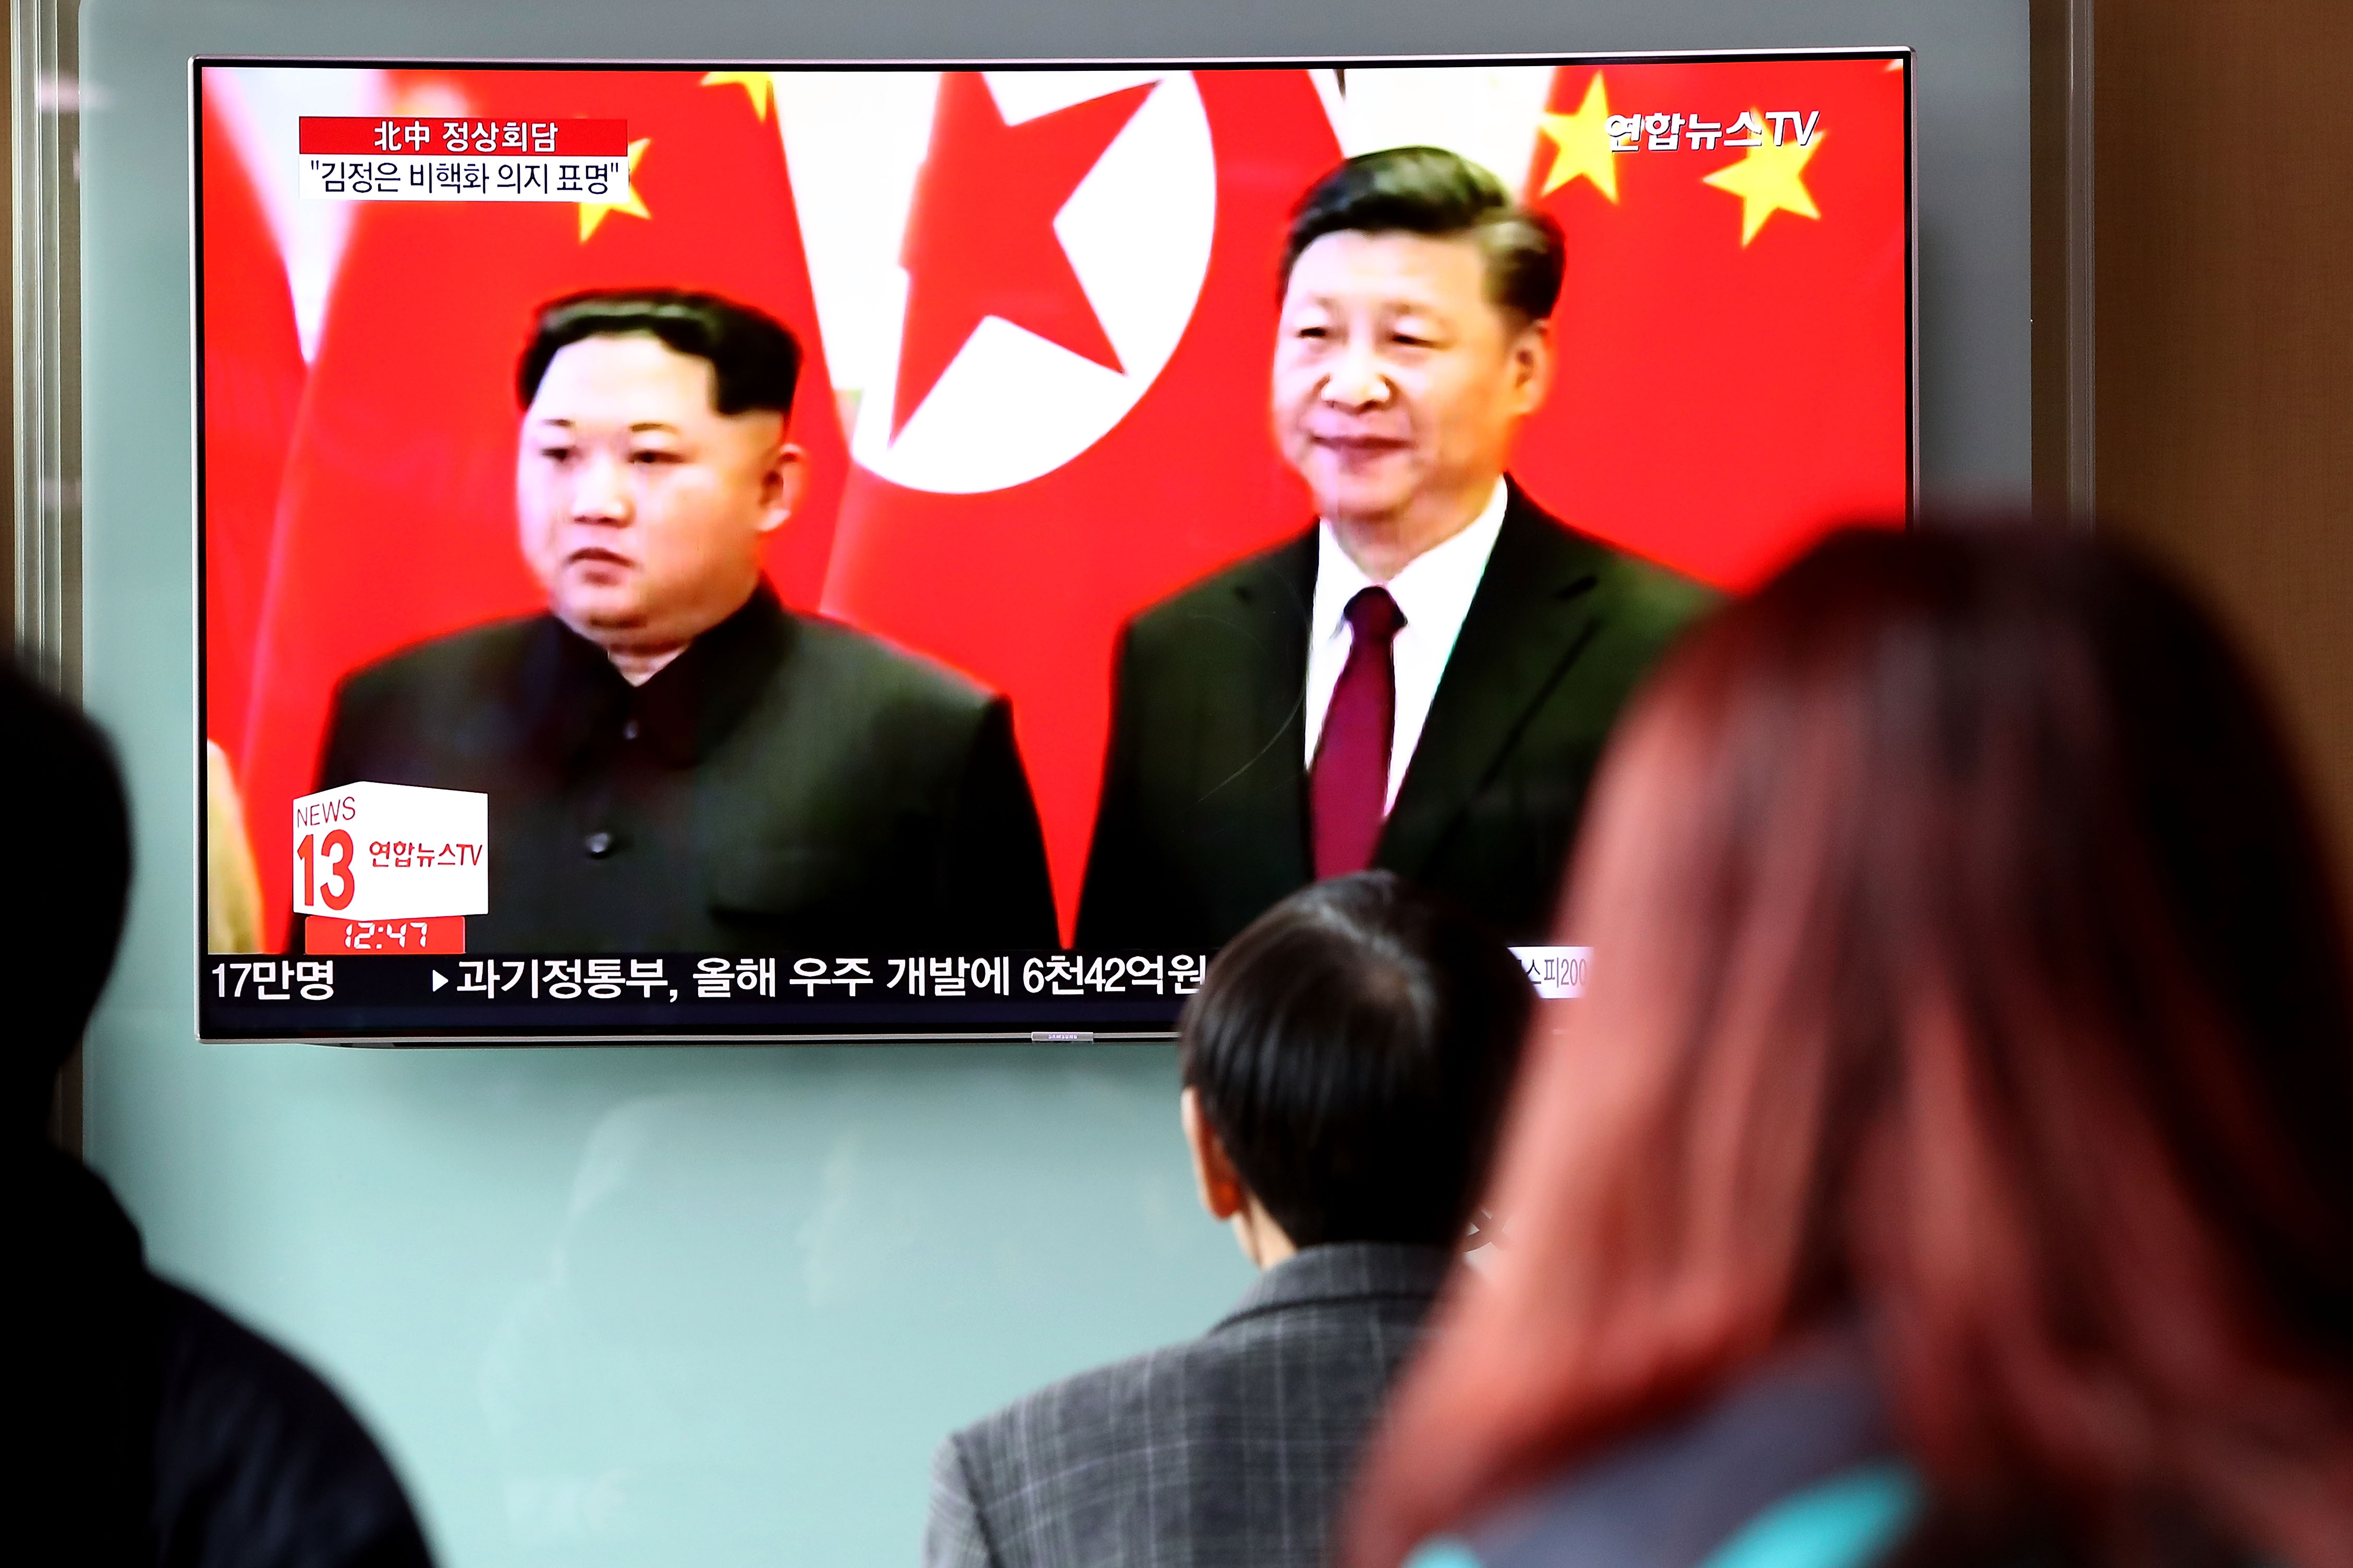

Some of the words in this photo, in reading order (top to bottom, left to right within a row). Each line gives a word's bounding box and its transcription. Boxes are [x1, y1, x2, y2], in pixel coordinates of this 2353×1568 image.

[373, 120, 430, 152] 北中
[442, 121, 558, 152] 정상회담
[1605, 111, 1820, 152] 연합뉴스TV
[310, 160, 401, 193] "김정은
[410, 163, 490, 194] 비핵화
[496, 163, 548, 194] 의지
[556, 162, 619, 194] 표명"
[297, 796, 356, 828] NEWS
[297, 829, 356, 911] 13
[369, 841, 483, 868] 연합뉴스TV
[344, 922, 428, 950] 12:47
[211, 959, 335, 1000] 17만명
[457, 958, 679, 1003] 과기정통부,
[692, 957, 776, 998] 올해
[789, 957, 874, 997] 우주
[886, 956, 1010, 997] 개발에
[1022, 953, 1208, 996] 6천42억원
